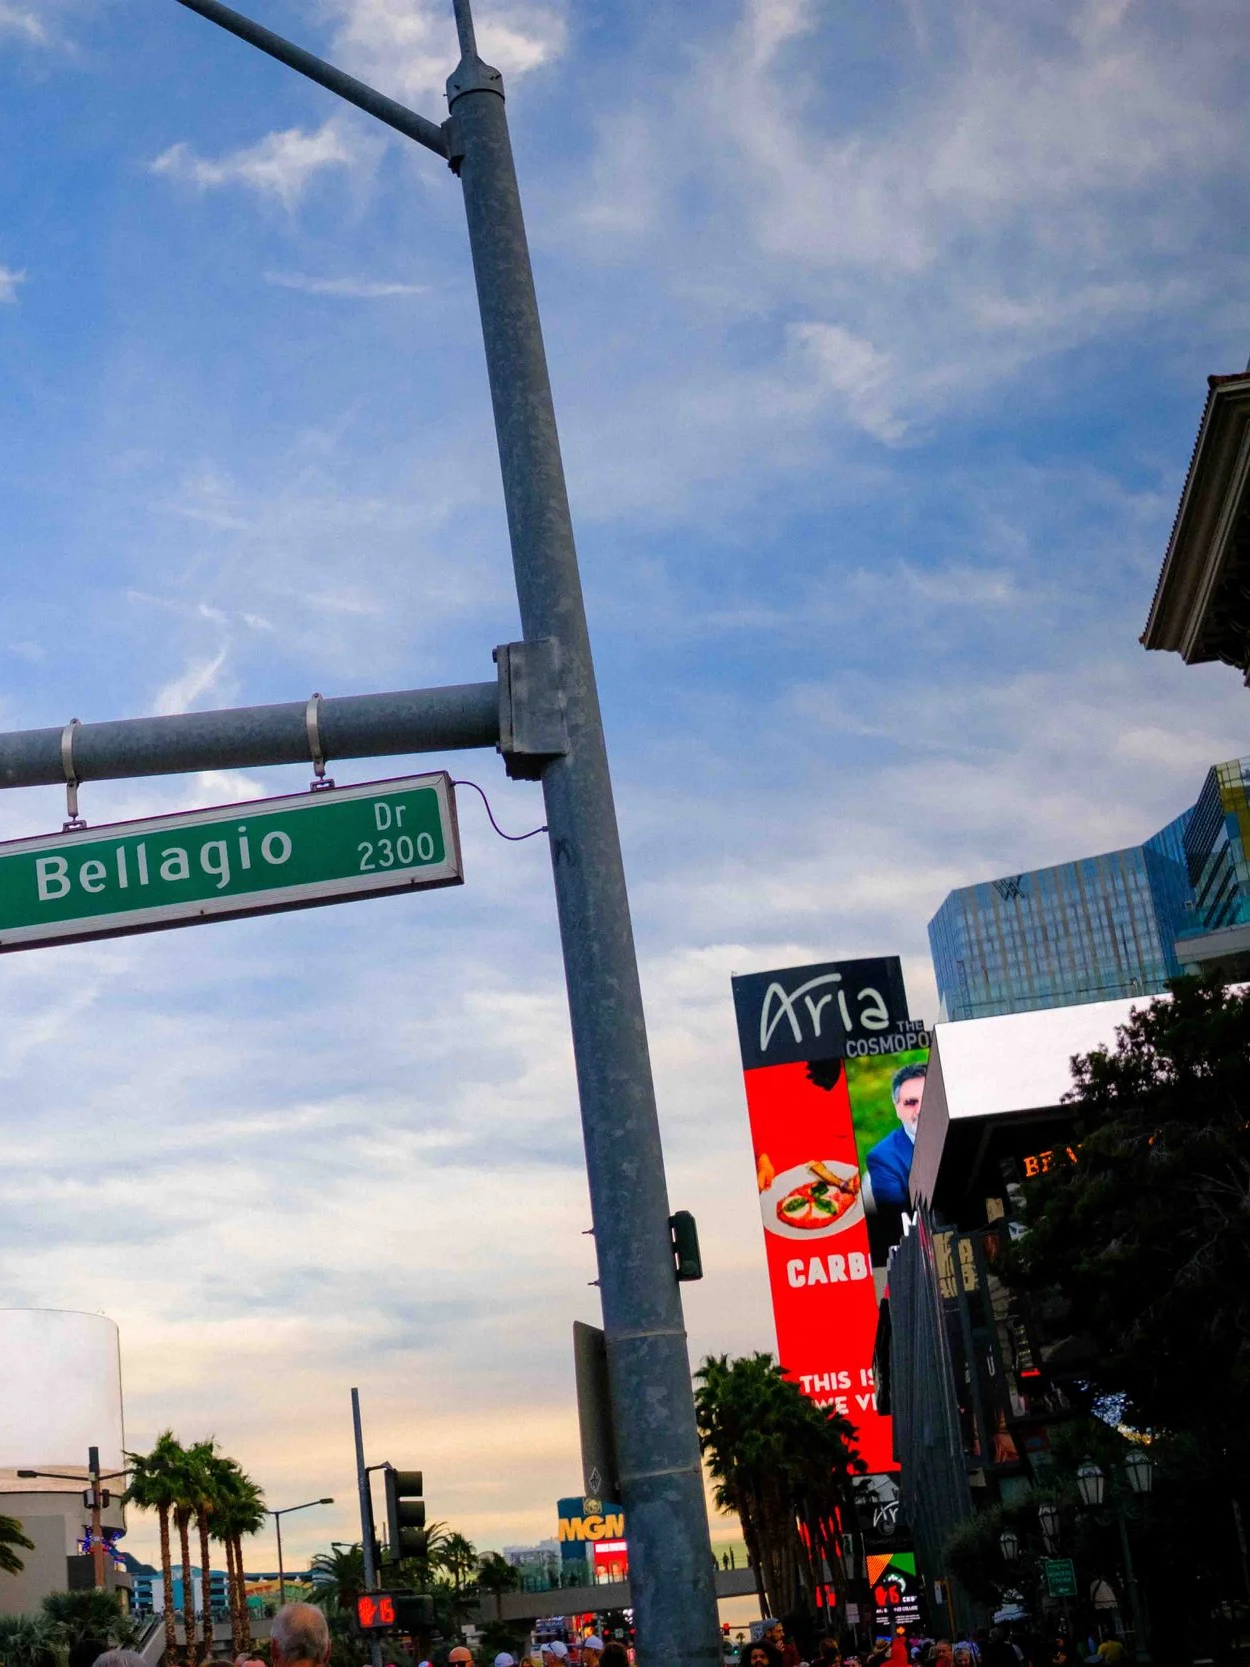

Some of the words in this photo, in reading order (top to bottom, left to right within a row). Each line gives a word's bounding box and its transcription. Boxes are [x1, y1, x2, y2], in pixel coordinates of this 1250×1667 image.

[35, 825, 293, 901] Bellagio
[374, 802, 407, 831] Dr
[357, 832, 435, 871] 2300
[760, 973, 889, 1051] Aria
[896, 1020, 924, 1032] THE
[846, 1032, 933, 1058] COSMOPO
[786, 1252, 873, 1288] CARB
[799, 1371, 852, 1393] THIS
